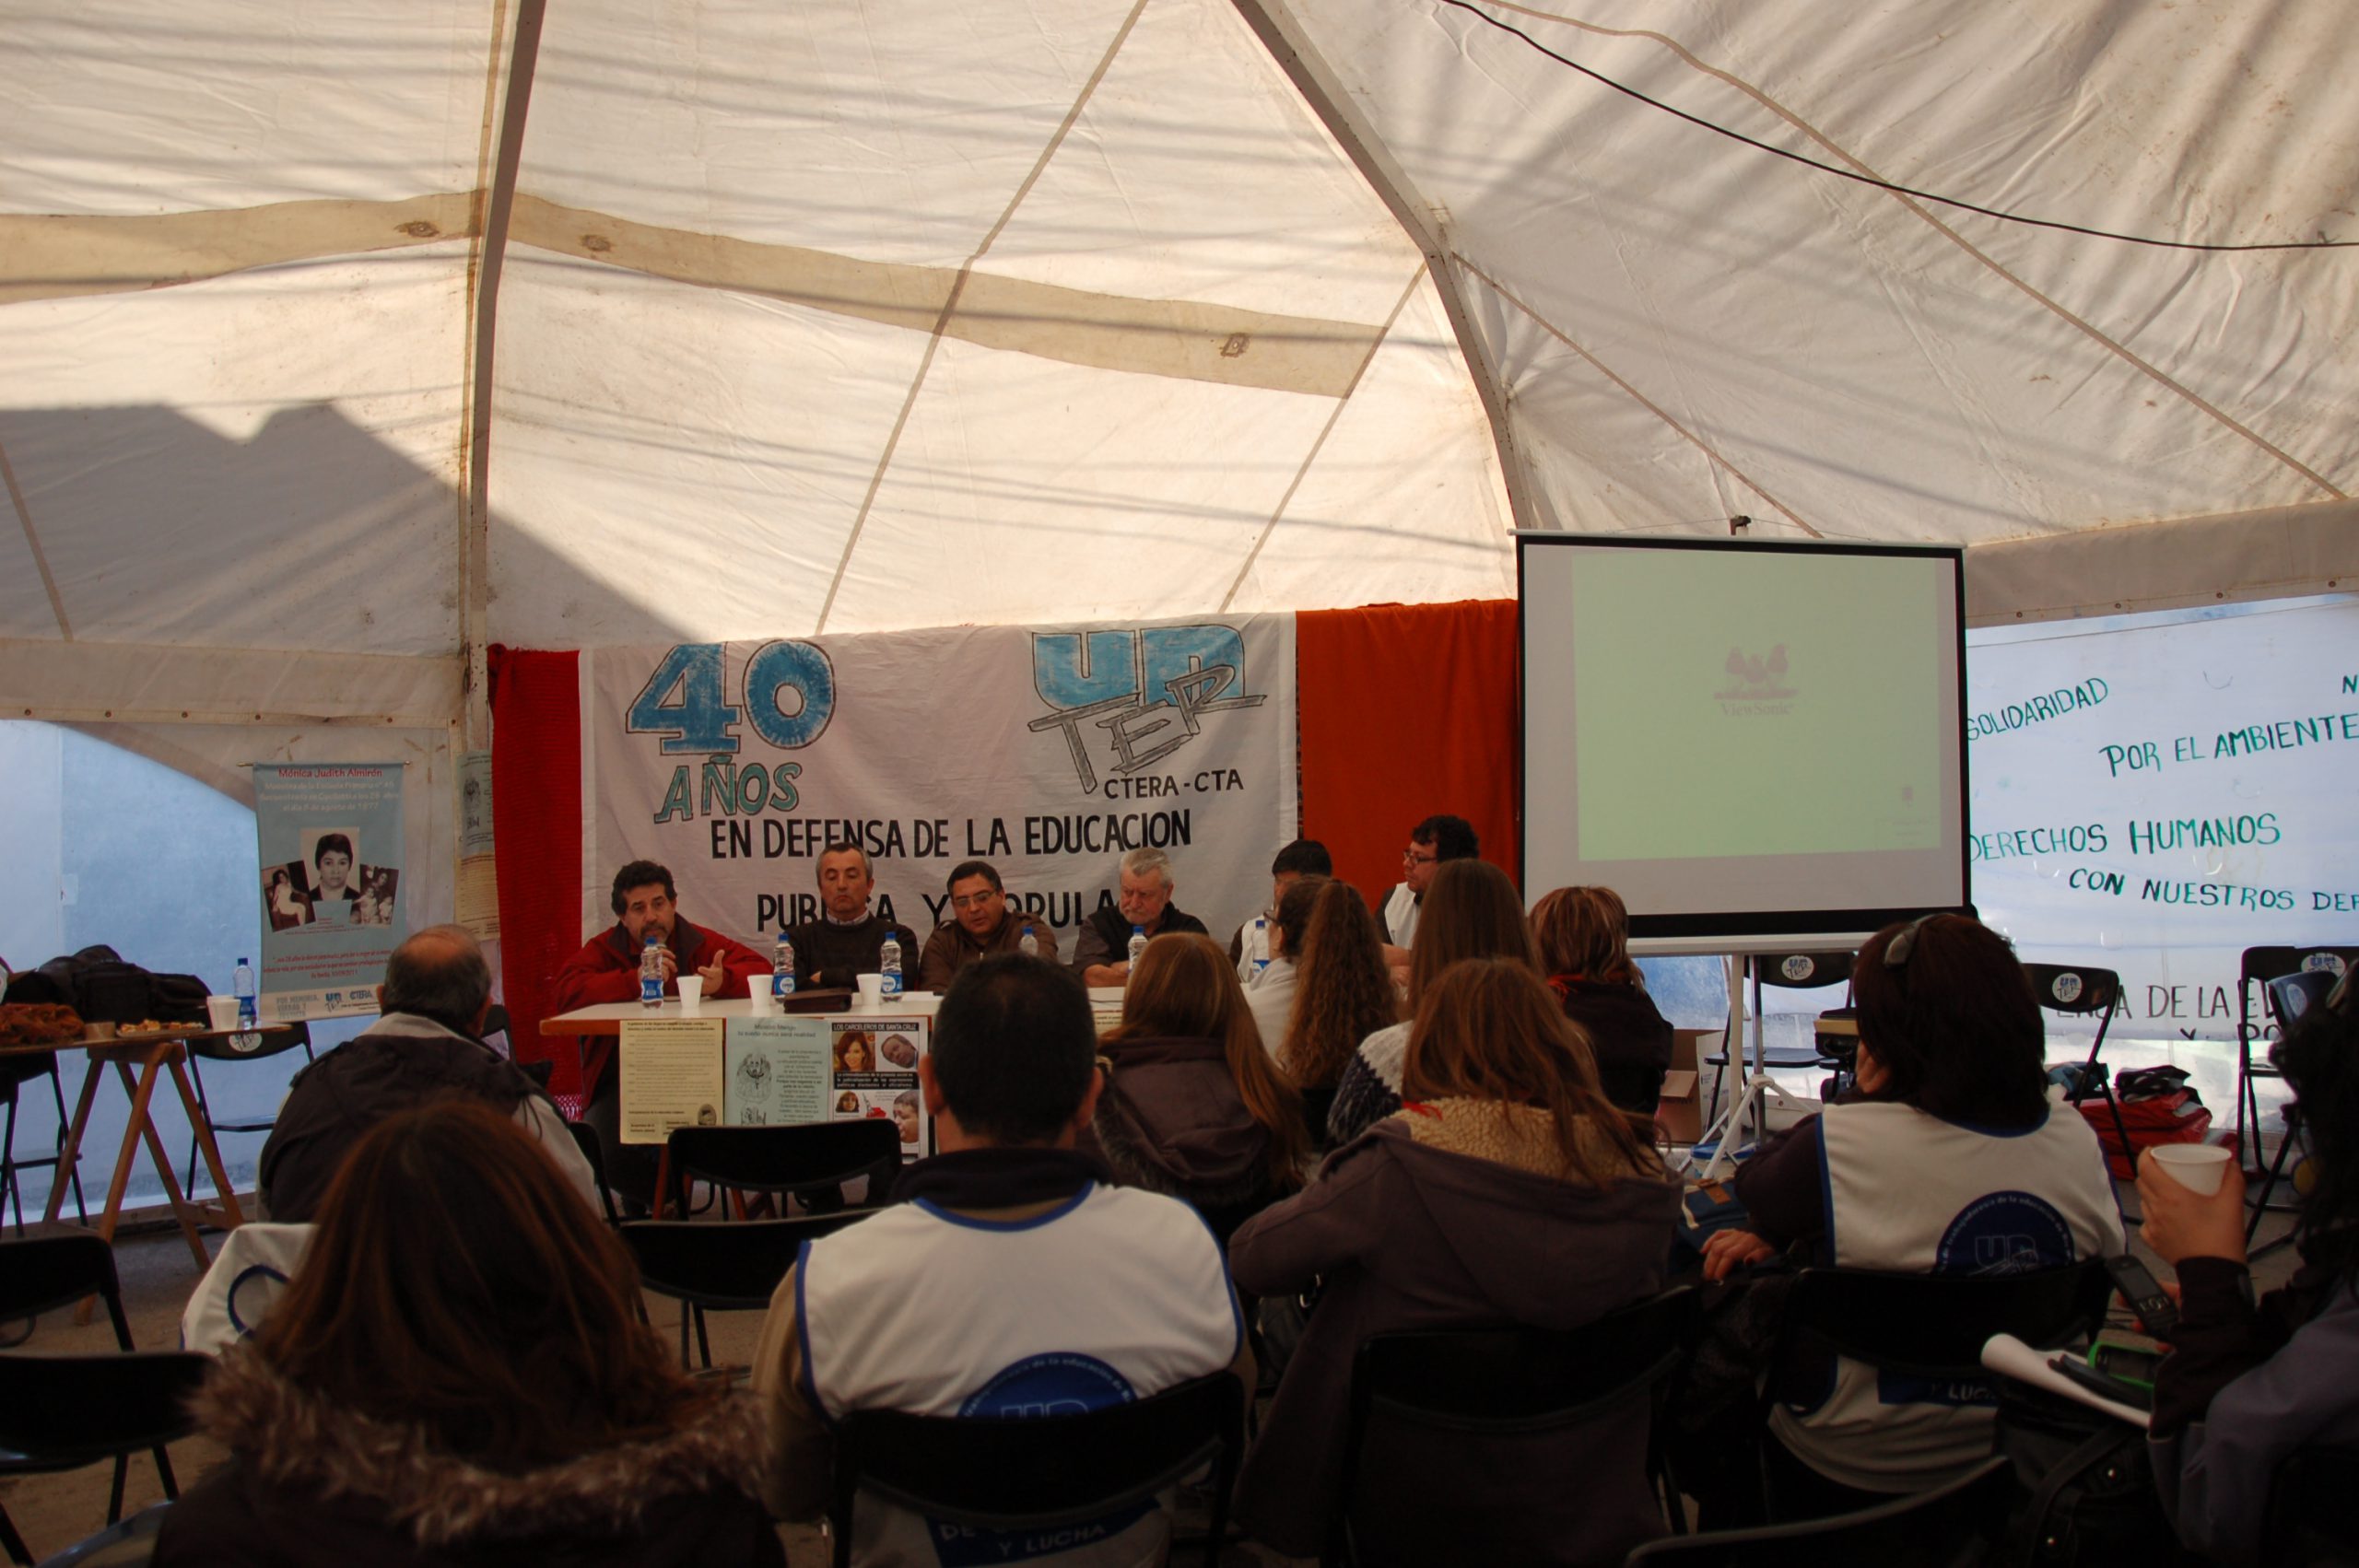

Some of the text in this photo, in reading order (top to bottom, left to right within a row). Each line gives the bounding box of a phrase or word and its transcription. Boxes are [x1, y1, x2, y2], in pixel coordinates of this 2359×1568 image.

[626, 639, 837, 755] 40
[1720, 702, 1792, 716] ViewSonic
[1967, 677, 2109, 741] SOLIDARIDAD
[1027, 664, 1268, 794] TER
[2099, 713, 2359, 777] POR EL AMBIENTE
[278, 766, 383, 778] Mónica Judith Almirón
[653, 755, 803, 824] AÑOS
[711, 808, 1192, 859] EN DEFENSA DE LA EDUCACION
[2129, 813, 2281, 855] HUMANOS
[921, 894, 950, 927] Y
[2069, 868, 2125, 895] CON
[2142, 880, 2294, 912] NUESTROS
[349, 989, 374, 1000] CTERA
[2146, 986, 2189, 1019] DE
[2198, 986, 2230, 1018] LA
[998, 1523, 1107, 1558] Y LUCHA
